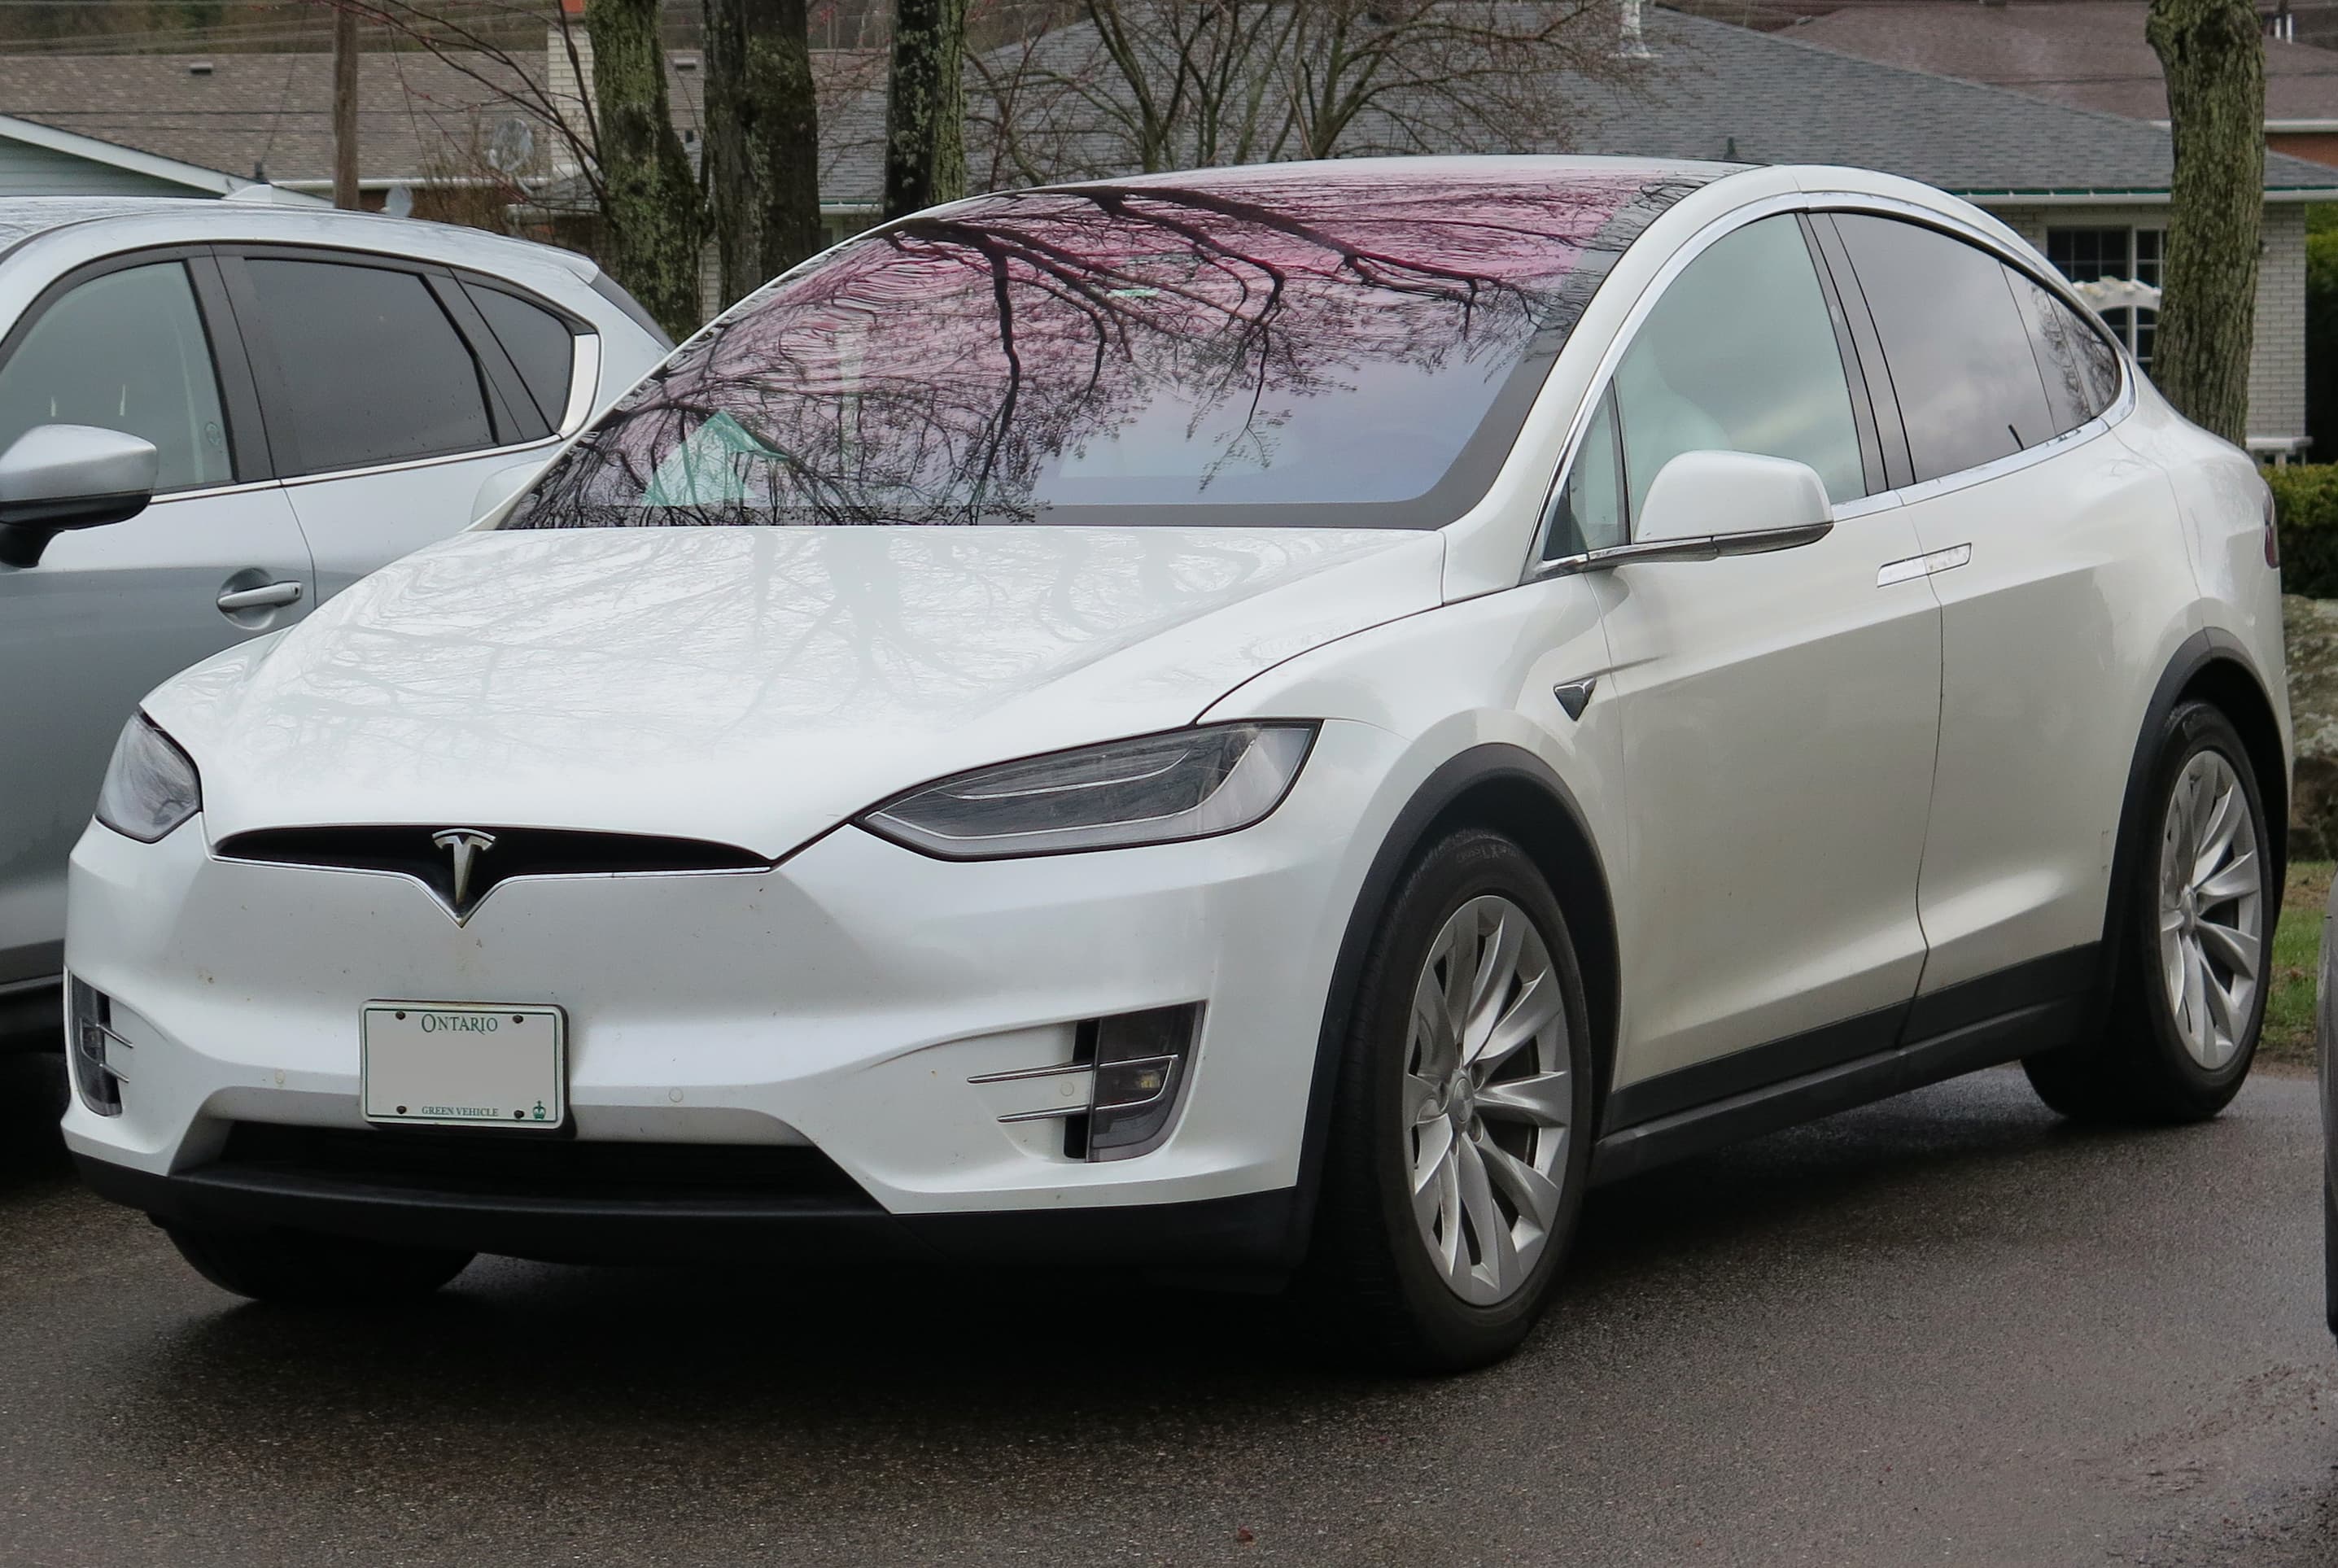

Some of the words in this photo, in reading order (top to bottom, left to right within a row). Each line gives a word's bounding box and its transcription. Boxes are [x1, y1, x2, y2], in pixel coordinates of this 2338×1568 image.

[422, 1013, 498, 1035] ONTARIO
[422, 1106, 454, 1115] GREEN
[456, 1107, 499, 1116] VEHICLE
